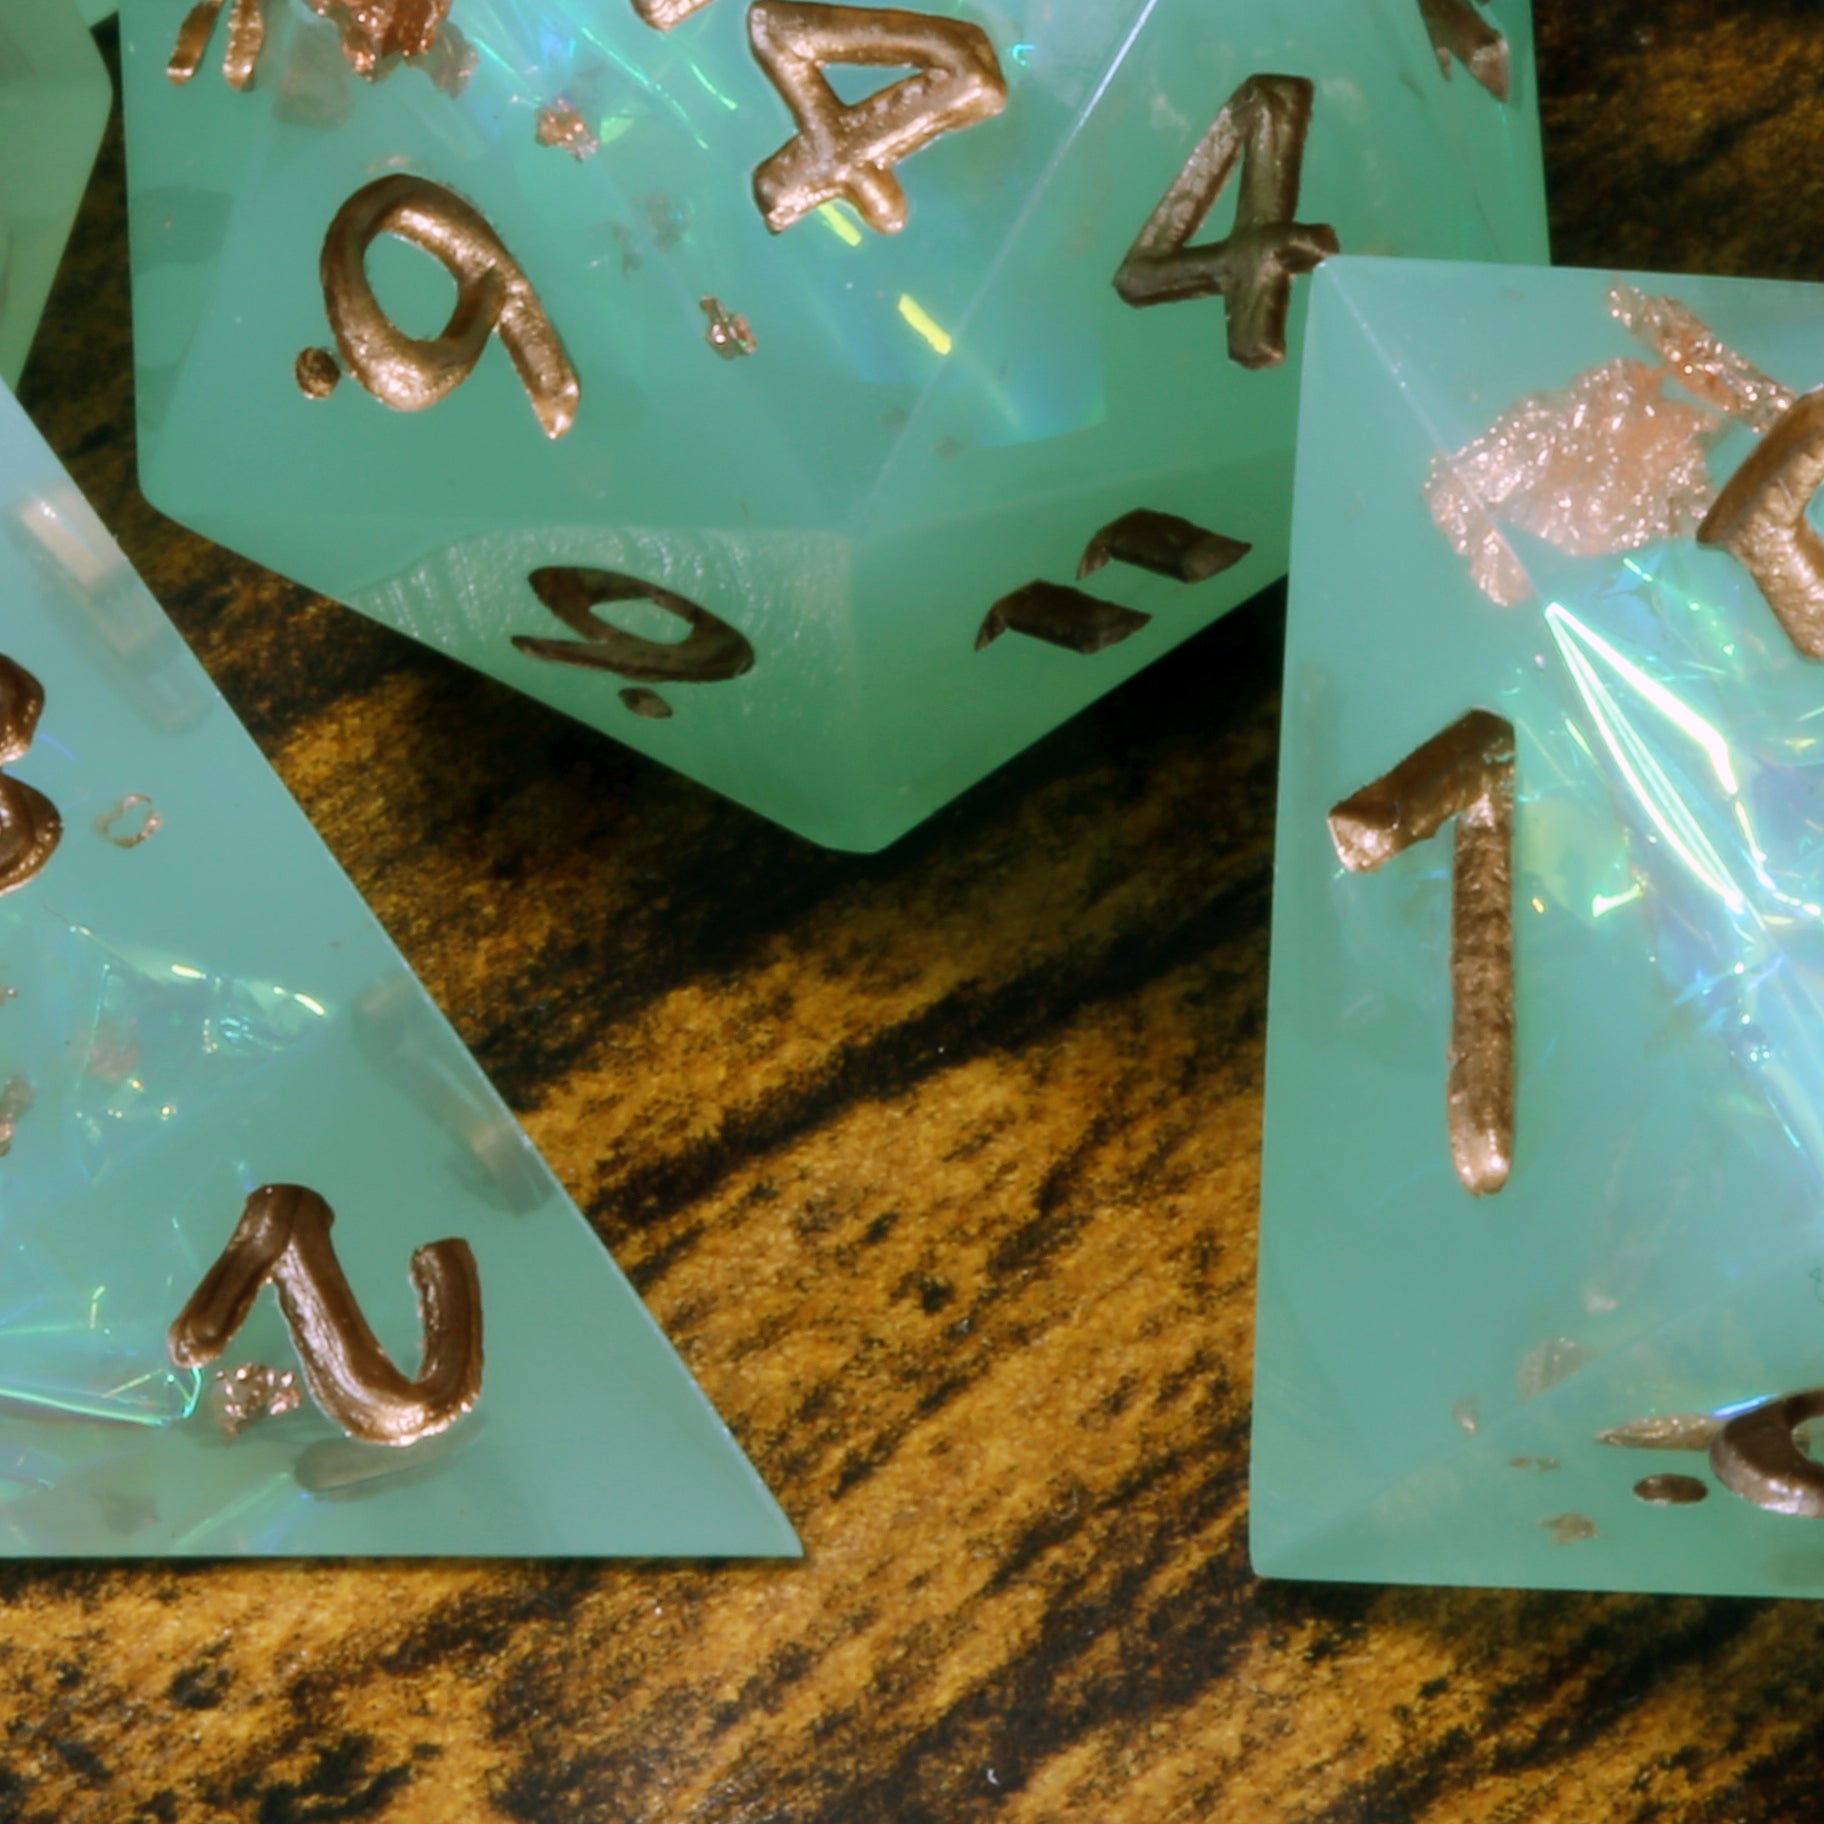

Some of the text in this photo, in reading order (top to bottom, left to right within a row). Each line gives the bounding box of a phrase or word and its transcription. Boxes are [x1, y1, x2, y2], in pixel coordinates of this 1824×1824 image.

[1112, 72, 1339, 371] 4
[1327, 709, 1516, 1196] 1
[171, 1182, 485, 1446] 2
